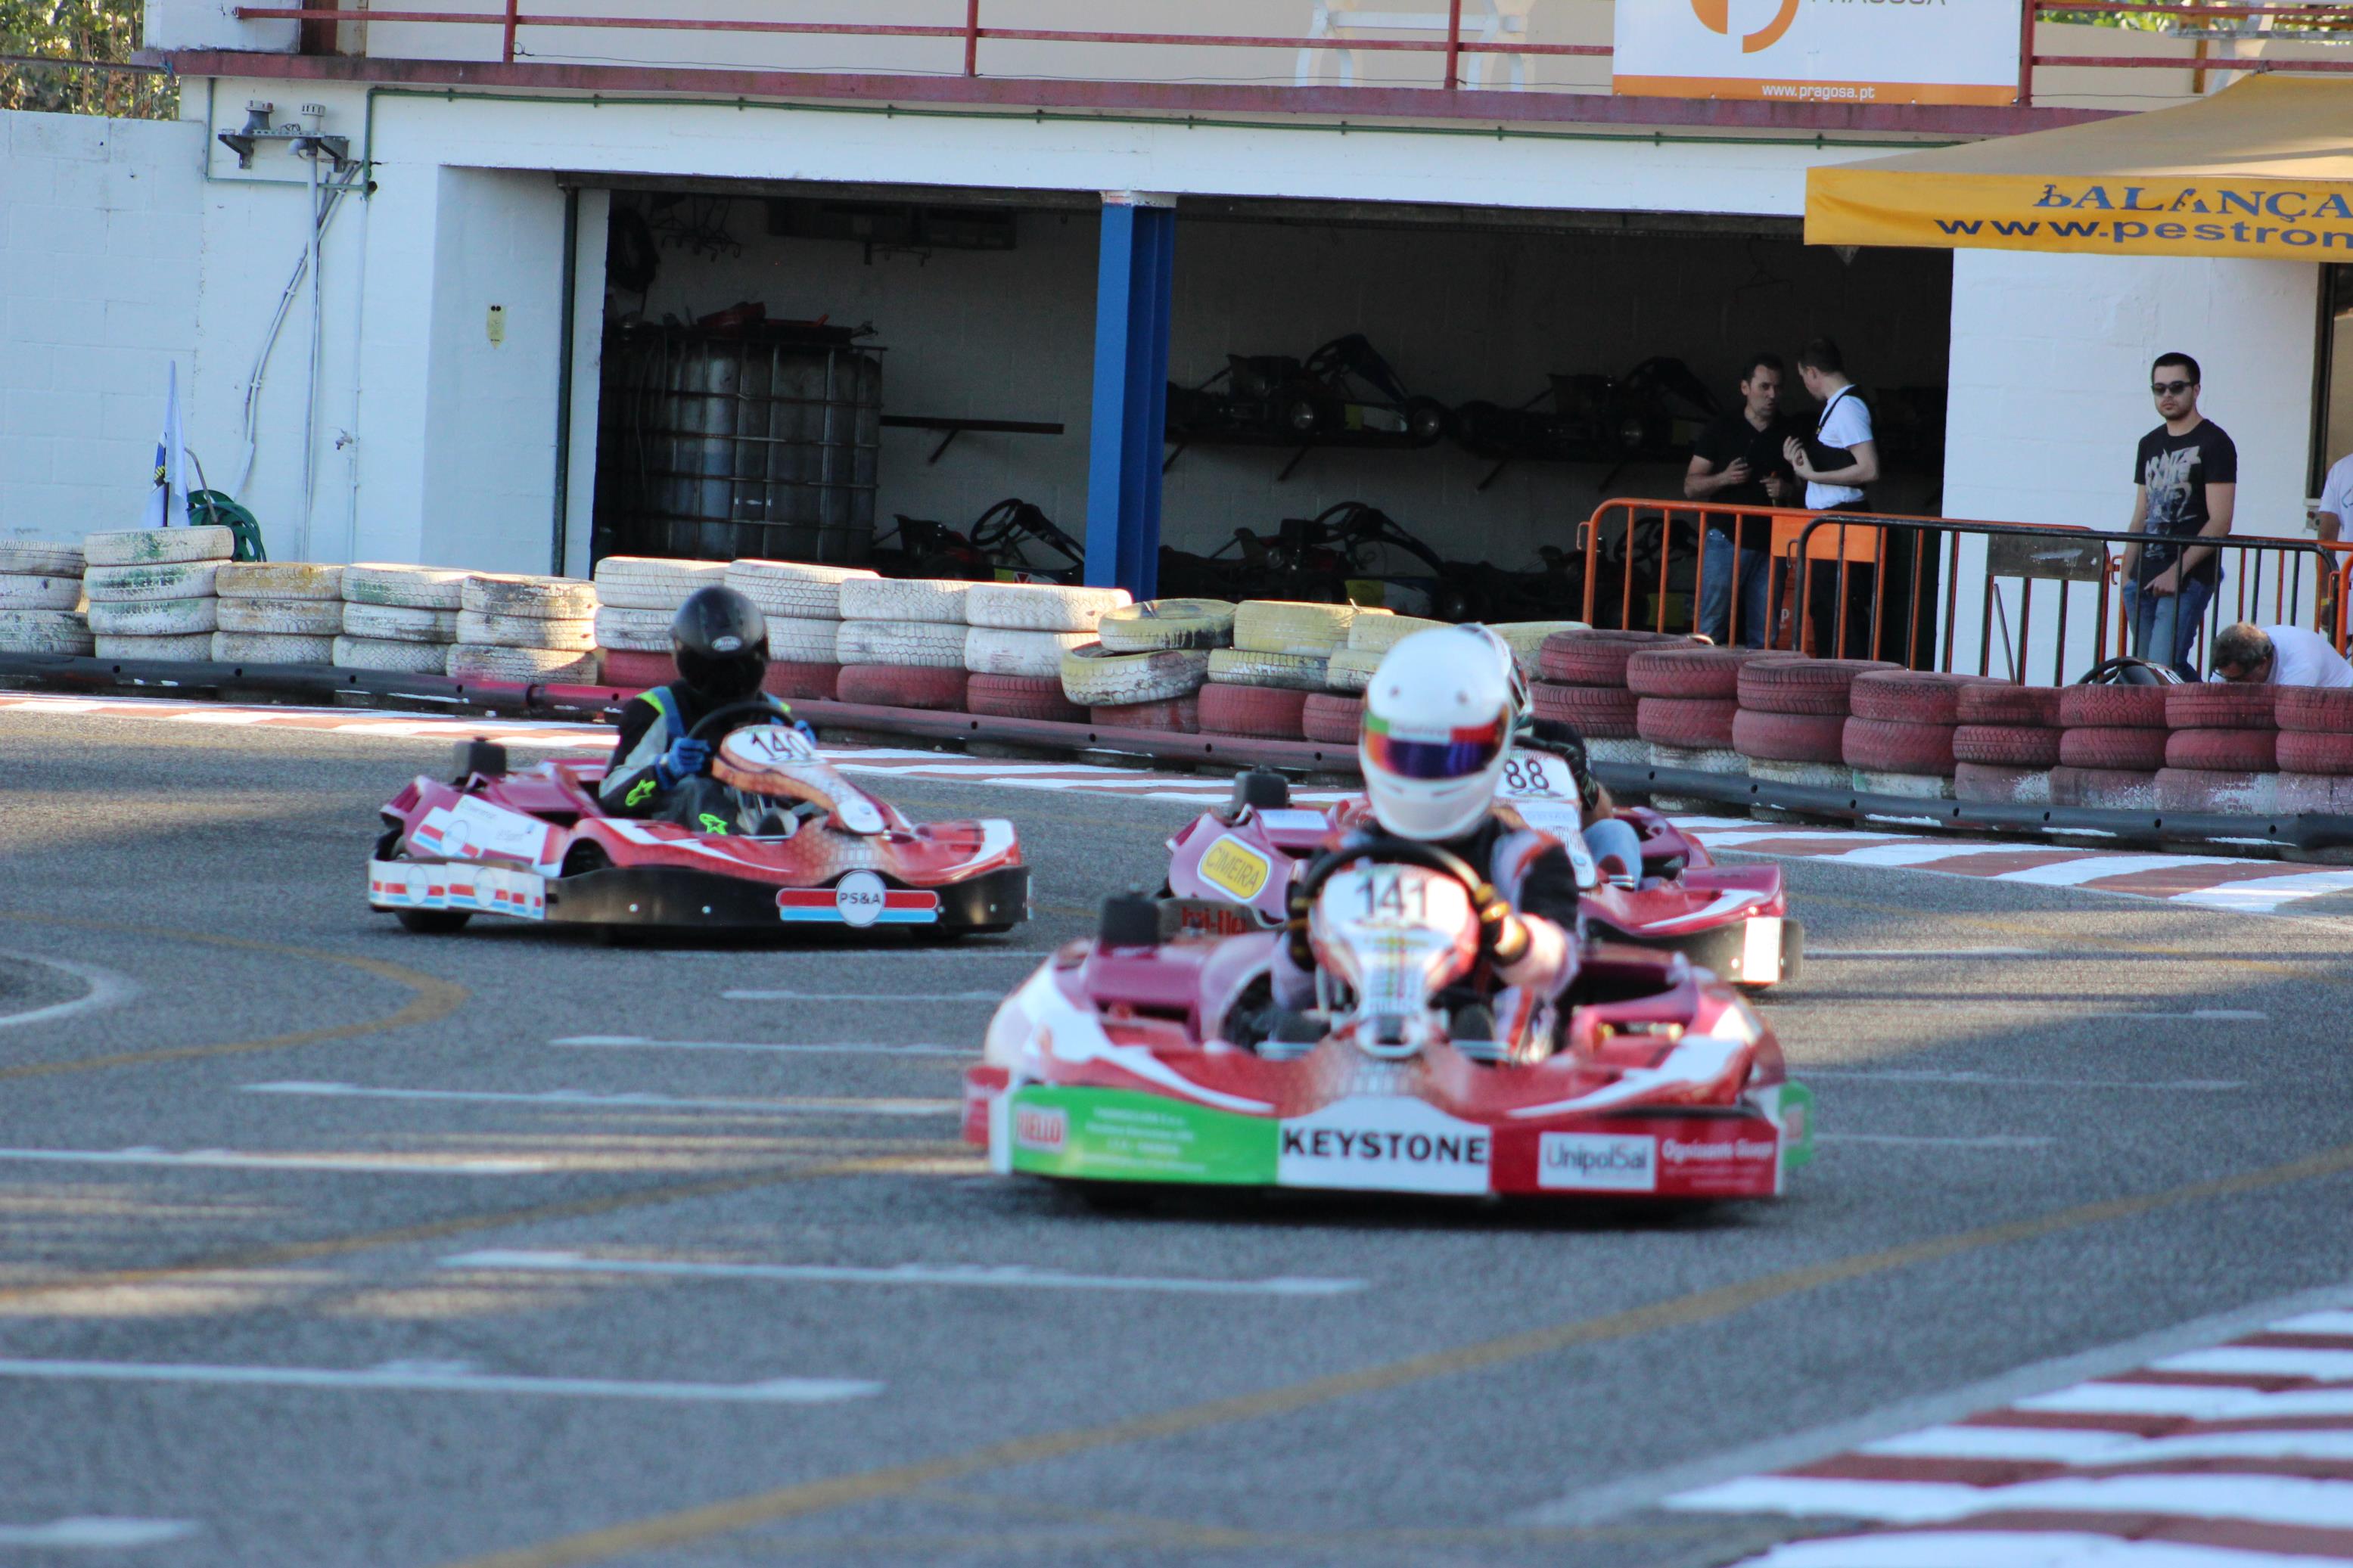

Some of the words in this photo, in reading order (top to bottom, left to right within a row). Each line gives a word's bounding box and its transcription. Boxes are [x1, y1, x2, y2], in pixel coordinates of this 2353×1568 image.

[1761, 85, 1876, 101] www.pragosa.pt
[750, 731, 812, 759] 140
[1205, 846, 1260, 892] CIMEIRA
[839, 892, 881, 905] PS&A
[1355, 876, 1427, 918] 141
[1282, 1127, 1487, 1164] KEYSTONE
